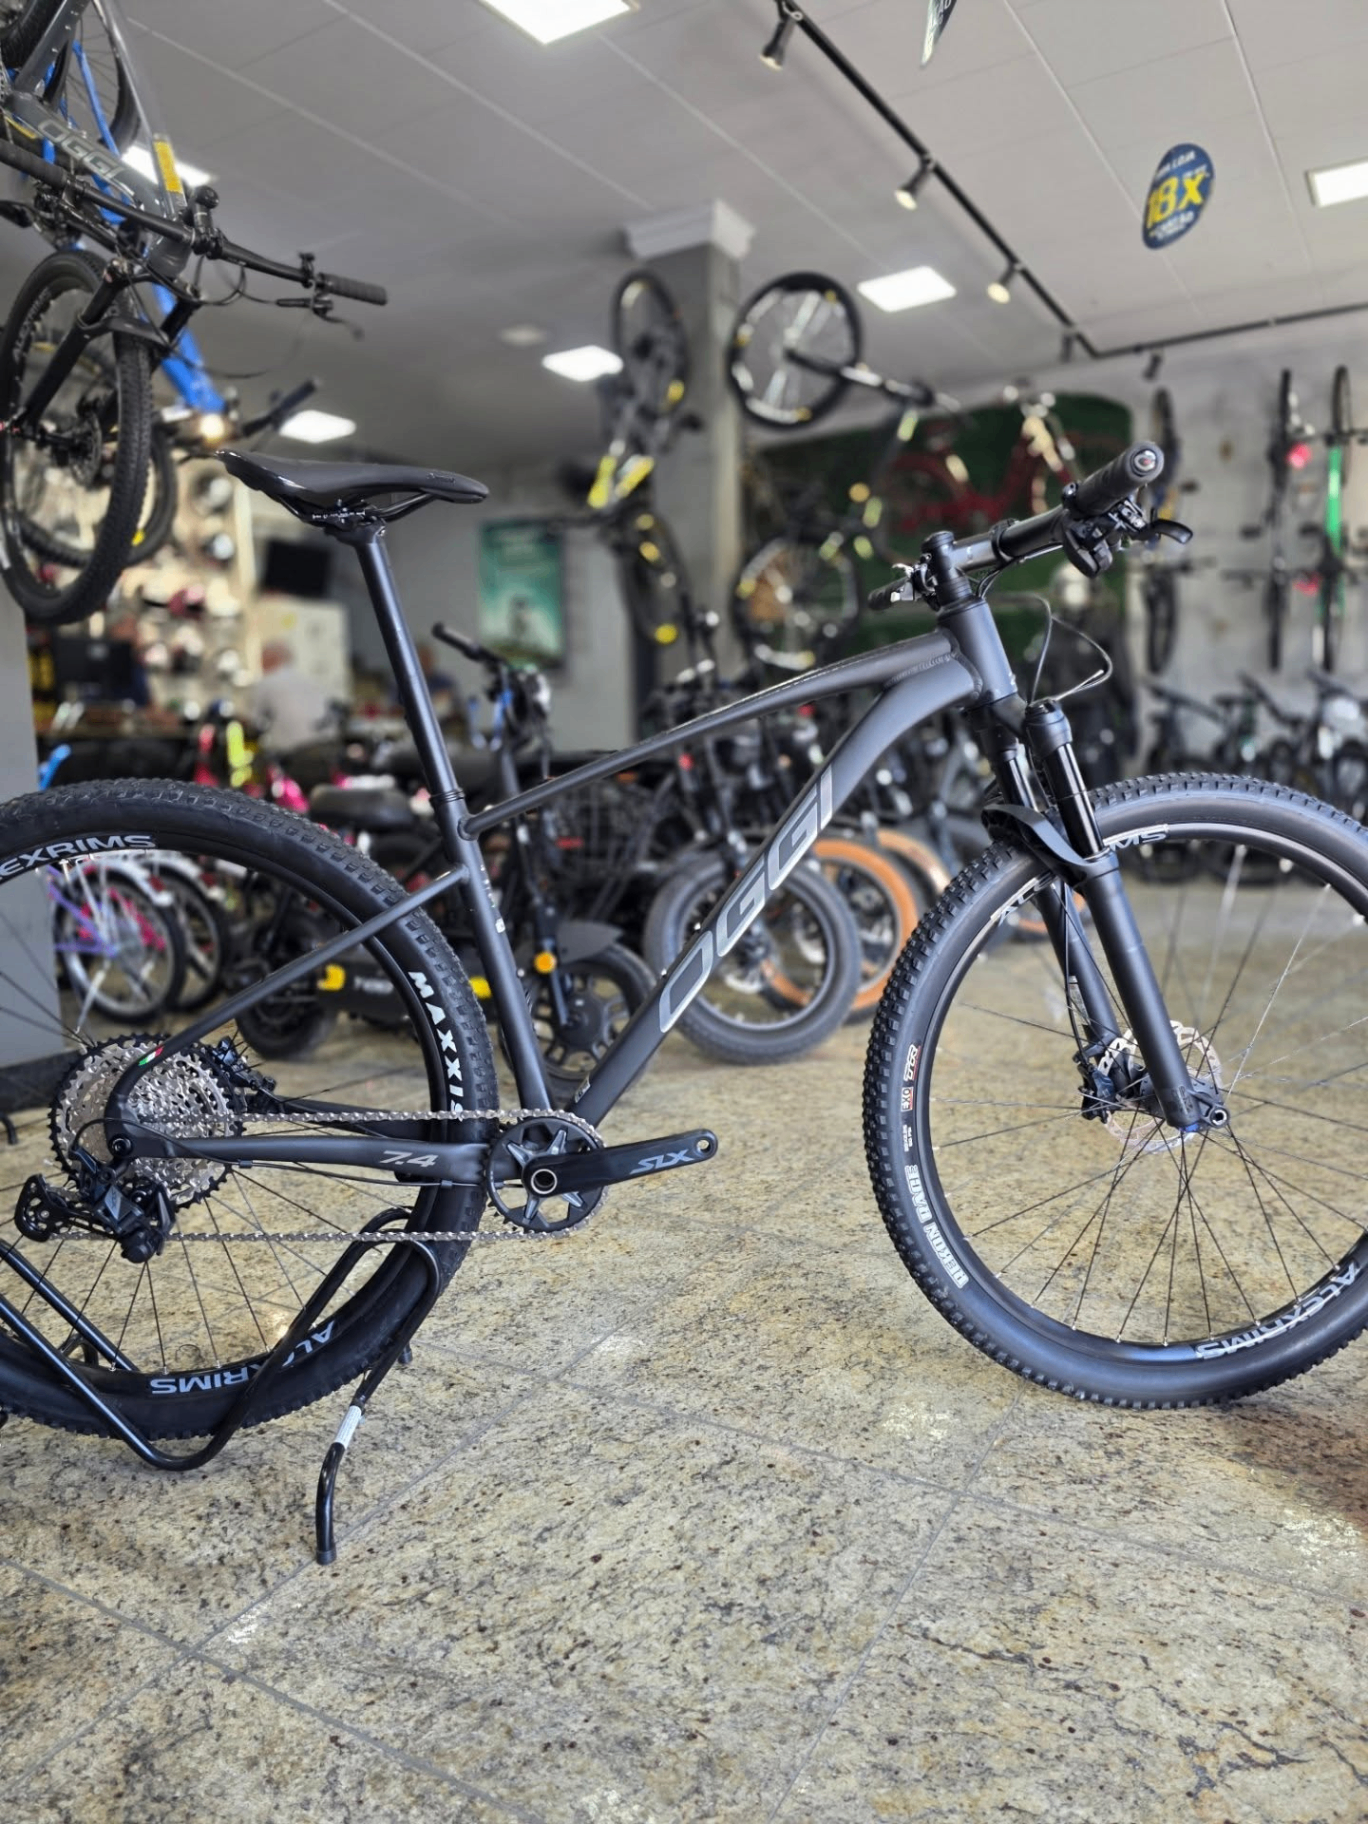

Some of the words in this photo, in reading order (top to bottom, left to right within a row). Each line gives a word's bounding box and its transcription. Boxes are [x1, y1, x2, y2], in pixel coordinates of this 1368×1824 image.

[0, 834, 156, 881] EXRIMS
[659, 764, 833, 1033] OGGI
[901, 1088, 913, 1111] EXO
[379, 1150, 439, 1168] 7.4
[629, 1149, 695, 1175] SLX
[1195, 1261, 1361, 1360] ALEXRIMS
